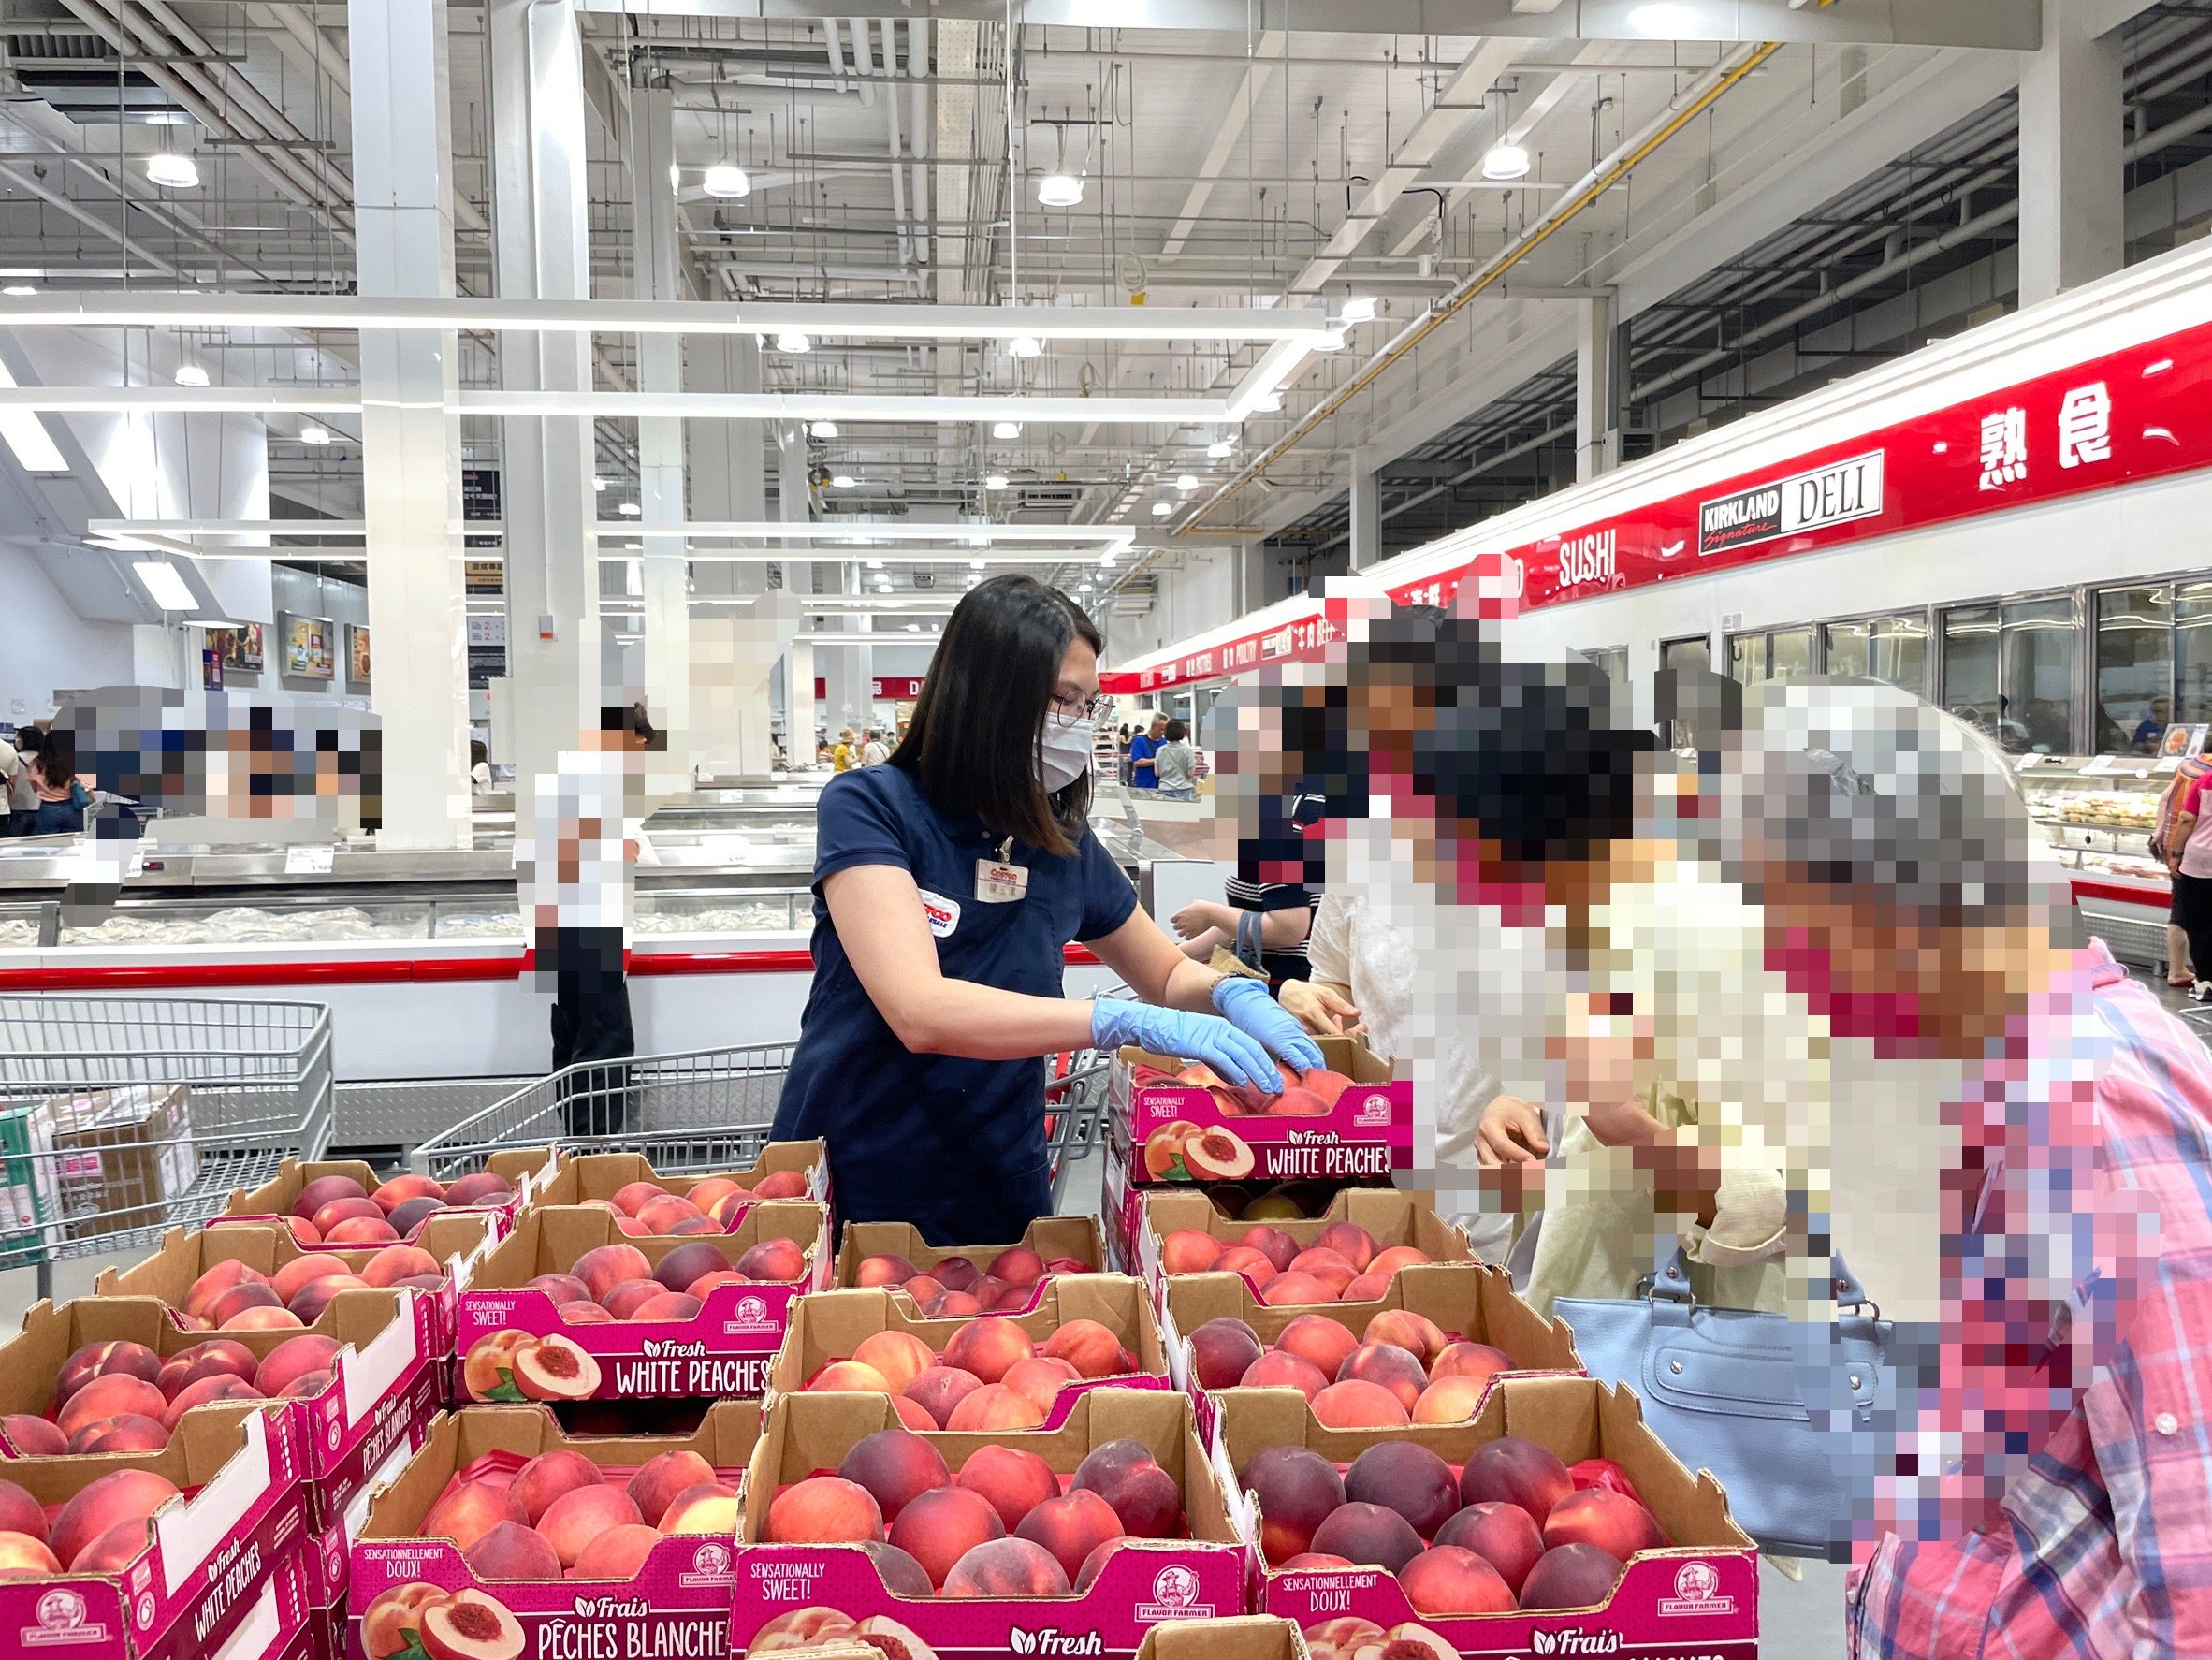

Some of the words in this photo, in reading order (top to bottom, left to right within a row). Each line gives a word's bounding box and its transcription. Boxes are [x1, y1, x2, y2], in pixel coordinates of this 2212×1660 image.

[1978, 381, 2111, 490] 熟食
[1704, 489, 1779, 533] KIRKLAND
[1797, 465, 1866, 525] DELI
[1703, 520, 1777, 550] Signature
[1559, 528, 1616, 587] SUSHI
[924, 903, 952, 922] TCO
[1143, 1096, 1185, 1106] SENSATIONALLY
[1150, 1106, 1178, 1118] SWEET!
[1303, 1130, 1340, 1145] Fresh
[1266, 1148, 1319, 1175] WHITE
[465, 1301, 517, 1311] SENSATIONALLY
[473, 1311, 506, 1326] SWEET!
[661, 1340, 706, 1358] Fresh
[616, 1361, 681, 1394] WHITE
[385, 1396, 412, 1451] BLANCHES
[216, 1537, 240, 1576] Fresh
[364, 1548, 444, 1560] SENSATIONNELLEMENT
[386, 1560, 421, 1579] DOUX!
[750, 1562, 825, 1579] SENSATIONALLY
[194, 1590, 226, 1642] WHITE
[225, 1540, 262, 1608] PEACHES
[762, 1578, 811, 1601] SWEET!
[1283, 1574, 1378, 1591] SENSATIONNELLEMENT
[596, 1597, 648, 1618] Frais
[1310, 1590, 1351, 1612] DOUX!
[1695, 1601, 1727, 1609] FARMER
[1173, 1609, 1208, 1617] FARMER
[538, 1618, 618, 1660] PÊCHES
[626, 1620, 727, 1660] BLANCHE
[1038, 1628, 1102, 1655] Fresh
[1557, 1628, 1618, 1654] Frais
